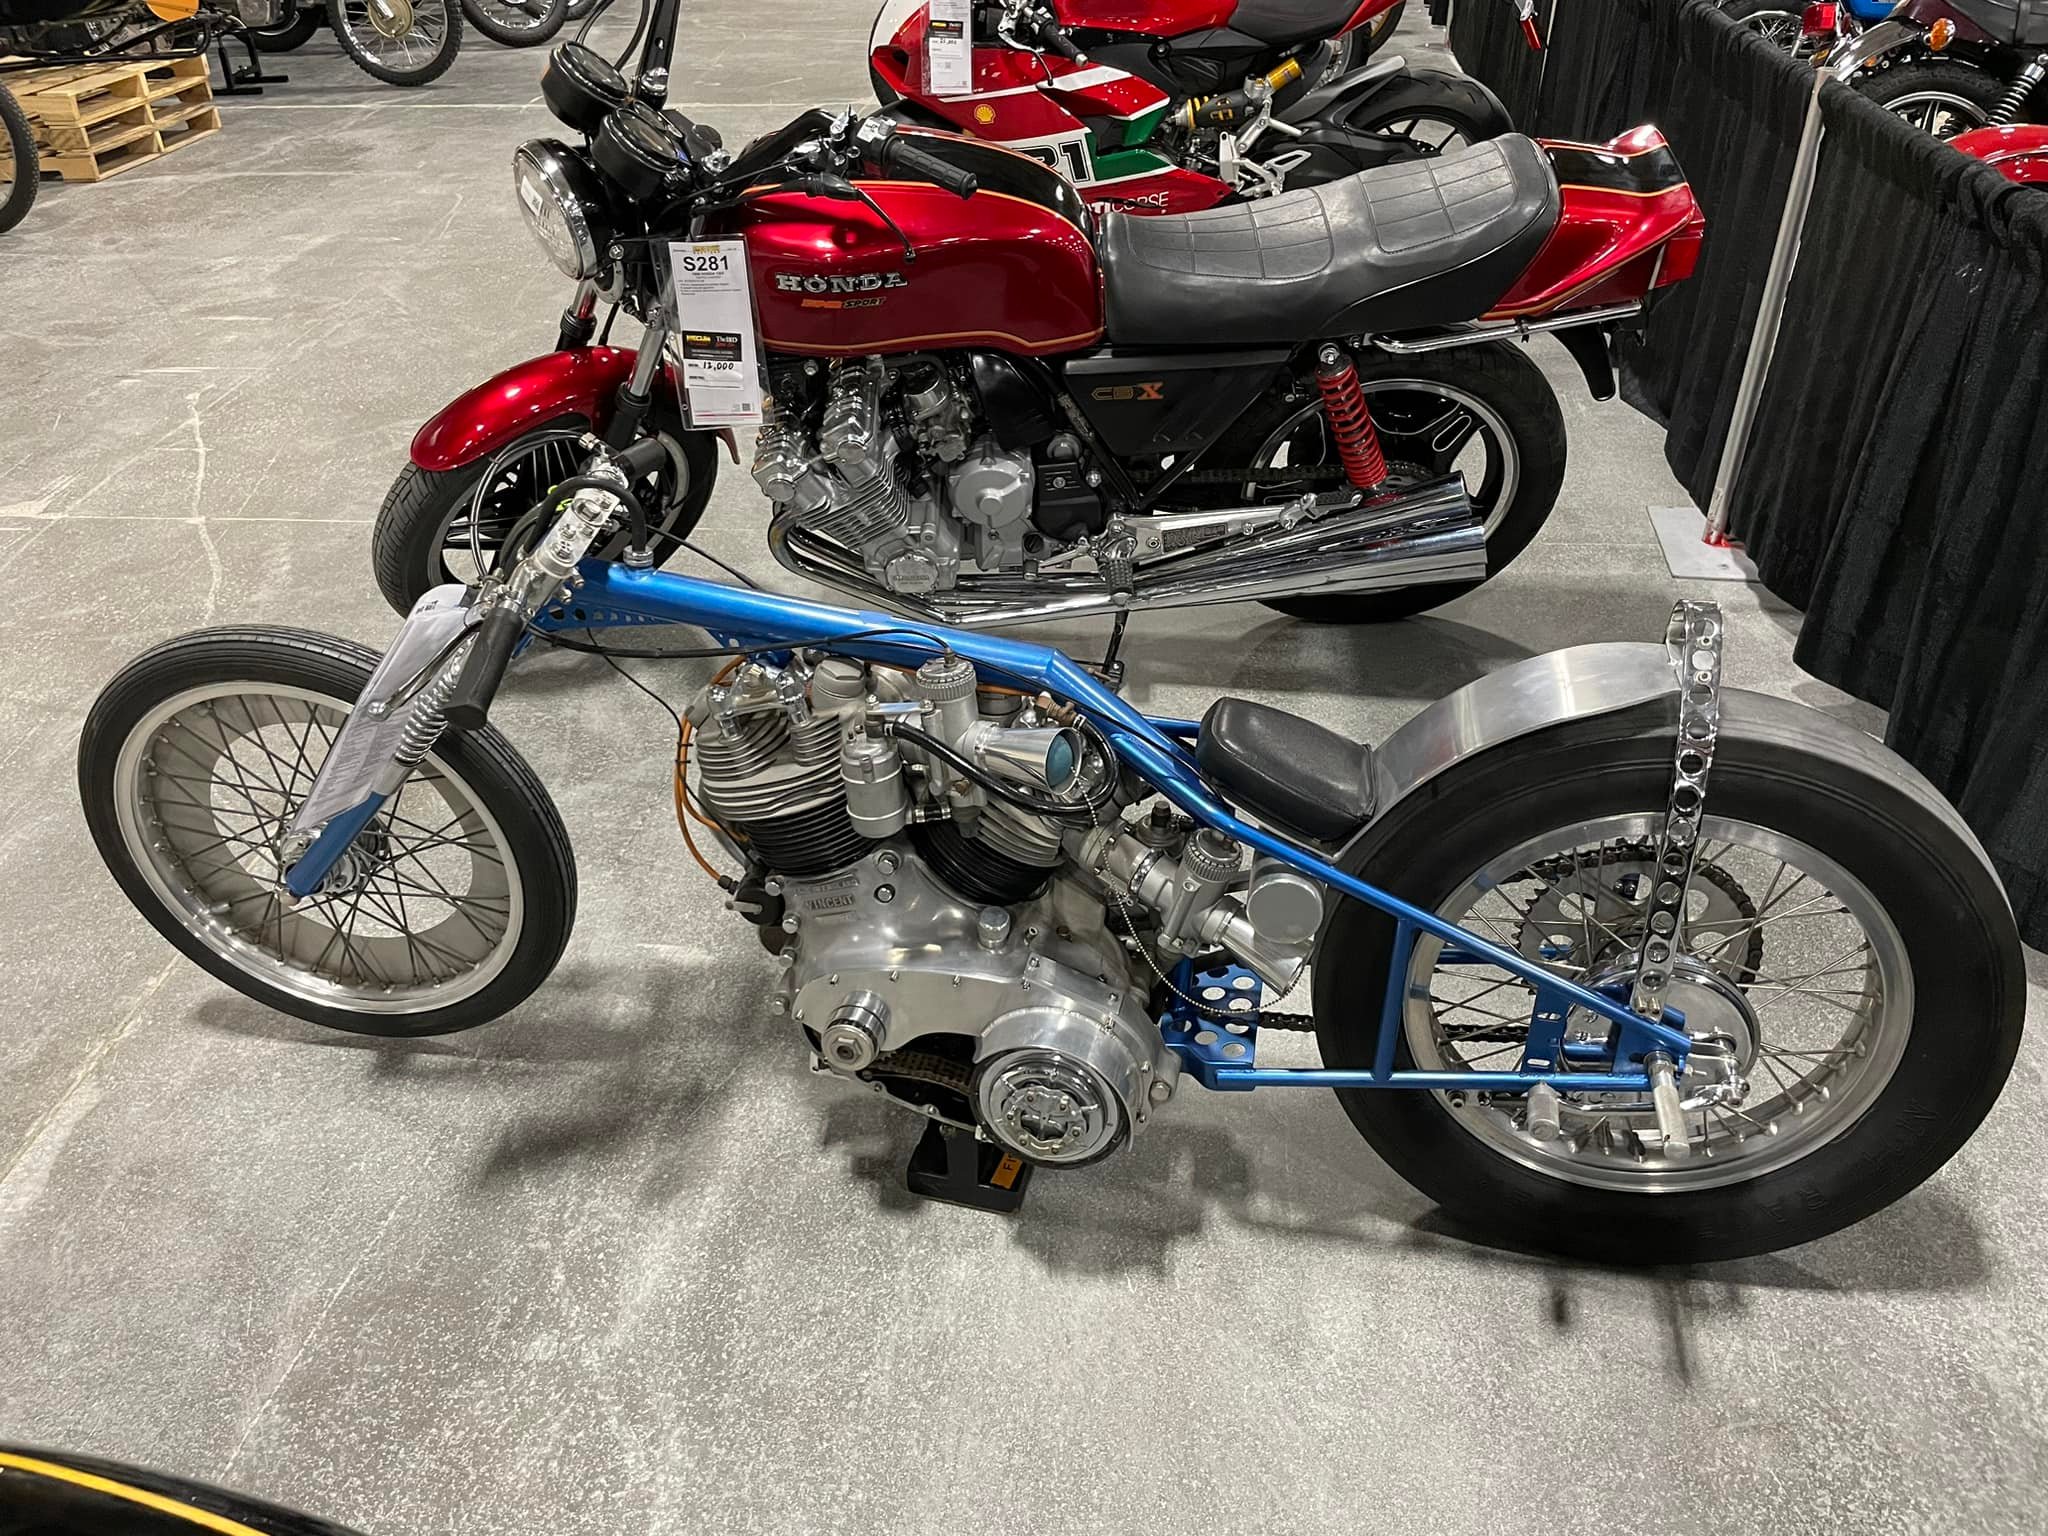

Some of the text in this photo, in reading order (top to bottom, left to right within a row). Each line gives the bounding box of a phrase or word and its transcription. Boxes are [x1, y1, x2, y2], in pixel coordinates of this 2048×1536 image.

[683, 255, 728, 272] S281
[775, 272, 908, 293] HONDA
[843, 296, 886, 309] SPORT
[806, 894, 855, 910] VINCENT
